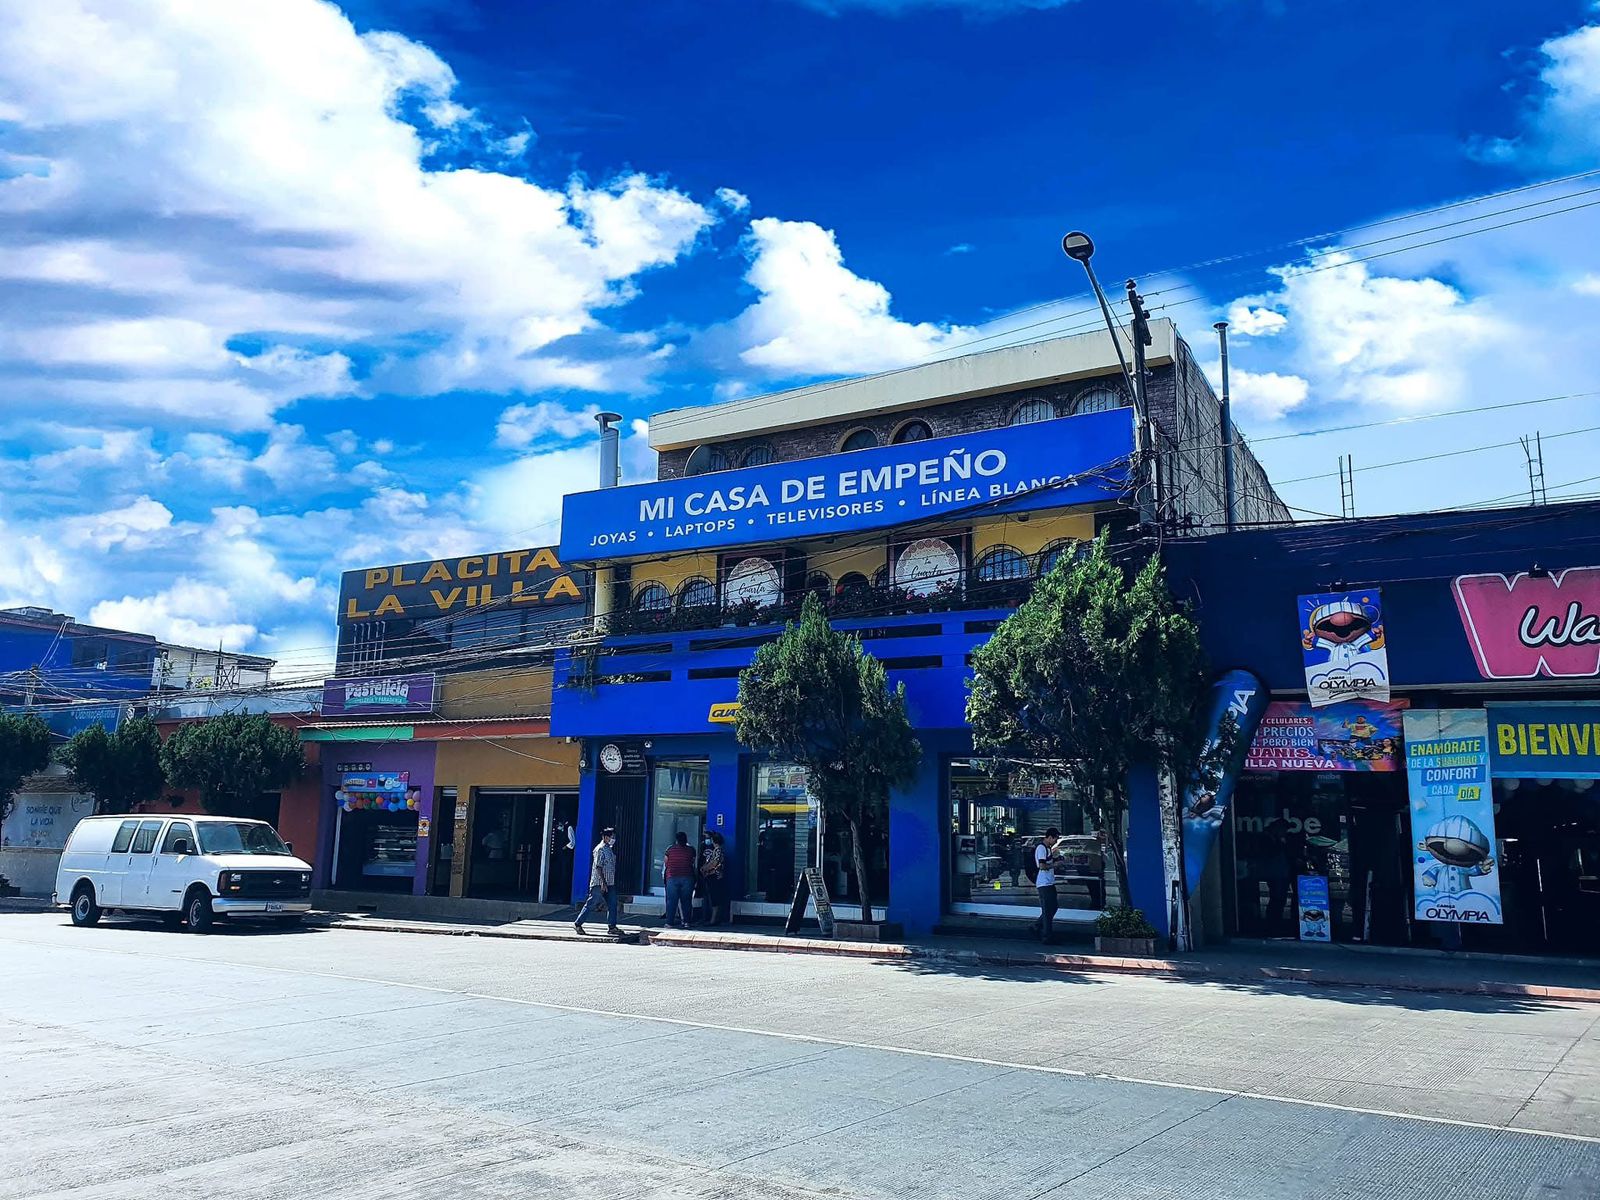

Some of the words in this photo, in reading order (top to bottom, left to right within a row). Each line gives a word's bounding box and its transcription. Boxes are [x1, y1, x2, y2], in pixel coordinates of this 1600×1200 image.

[639, 496, 674, 522] MI
[684, 484, 770, 517] CASA
[781, 475, 826, 504] DE
[838, 447, 1008, 498] EMPEÑO
[589, 530, 638, 547] JOYAS
[665, 518, 736, 538] LAPTOPS
[766, 499, 885, 526] TELEVISORES
[920, 488, 981, 507] LÍNEA
[988, 472, 1080, 499] BLANCA
[364, 547, 562, 590] PLACITA
[346, 594, 406, 619] LA
[430, 574, 582, 610] VILLA
[1318, 677, 1377, 690] OLYMPIA
[1262, 726, 1315, 737] PRECIOS
[1410, 739, 1481, 757] ENAMÓRATE
[1244, 759, 1277, 768] ILLA
[1281, 759, 1335, 769] NUEVA
[1426, 767, 1478, 782] CONFORT
[1431, 784, 1455, 795] CADA
[1236, 808, 1322, 834] mbe
[1425, 907, 1491, 922] OLYMPIA
